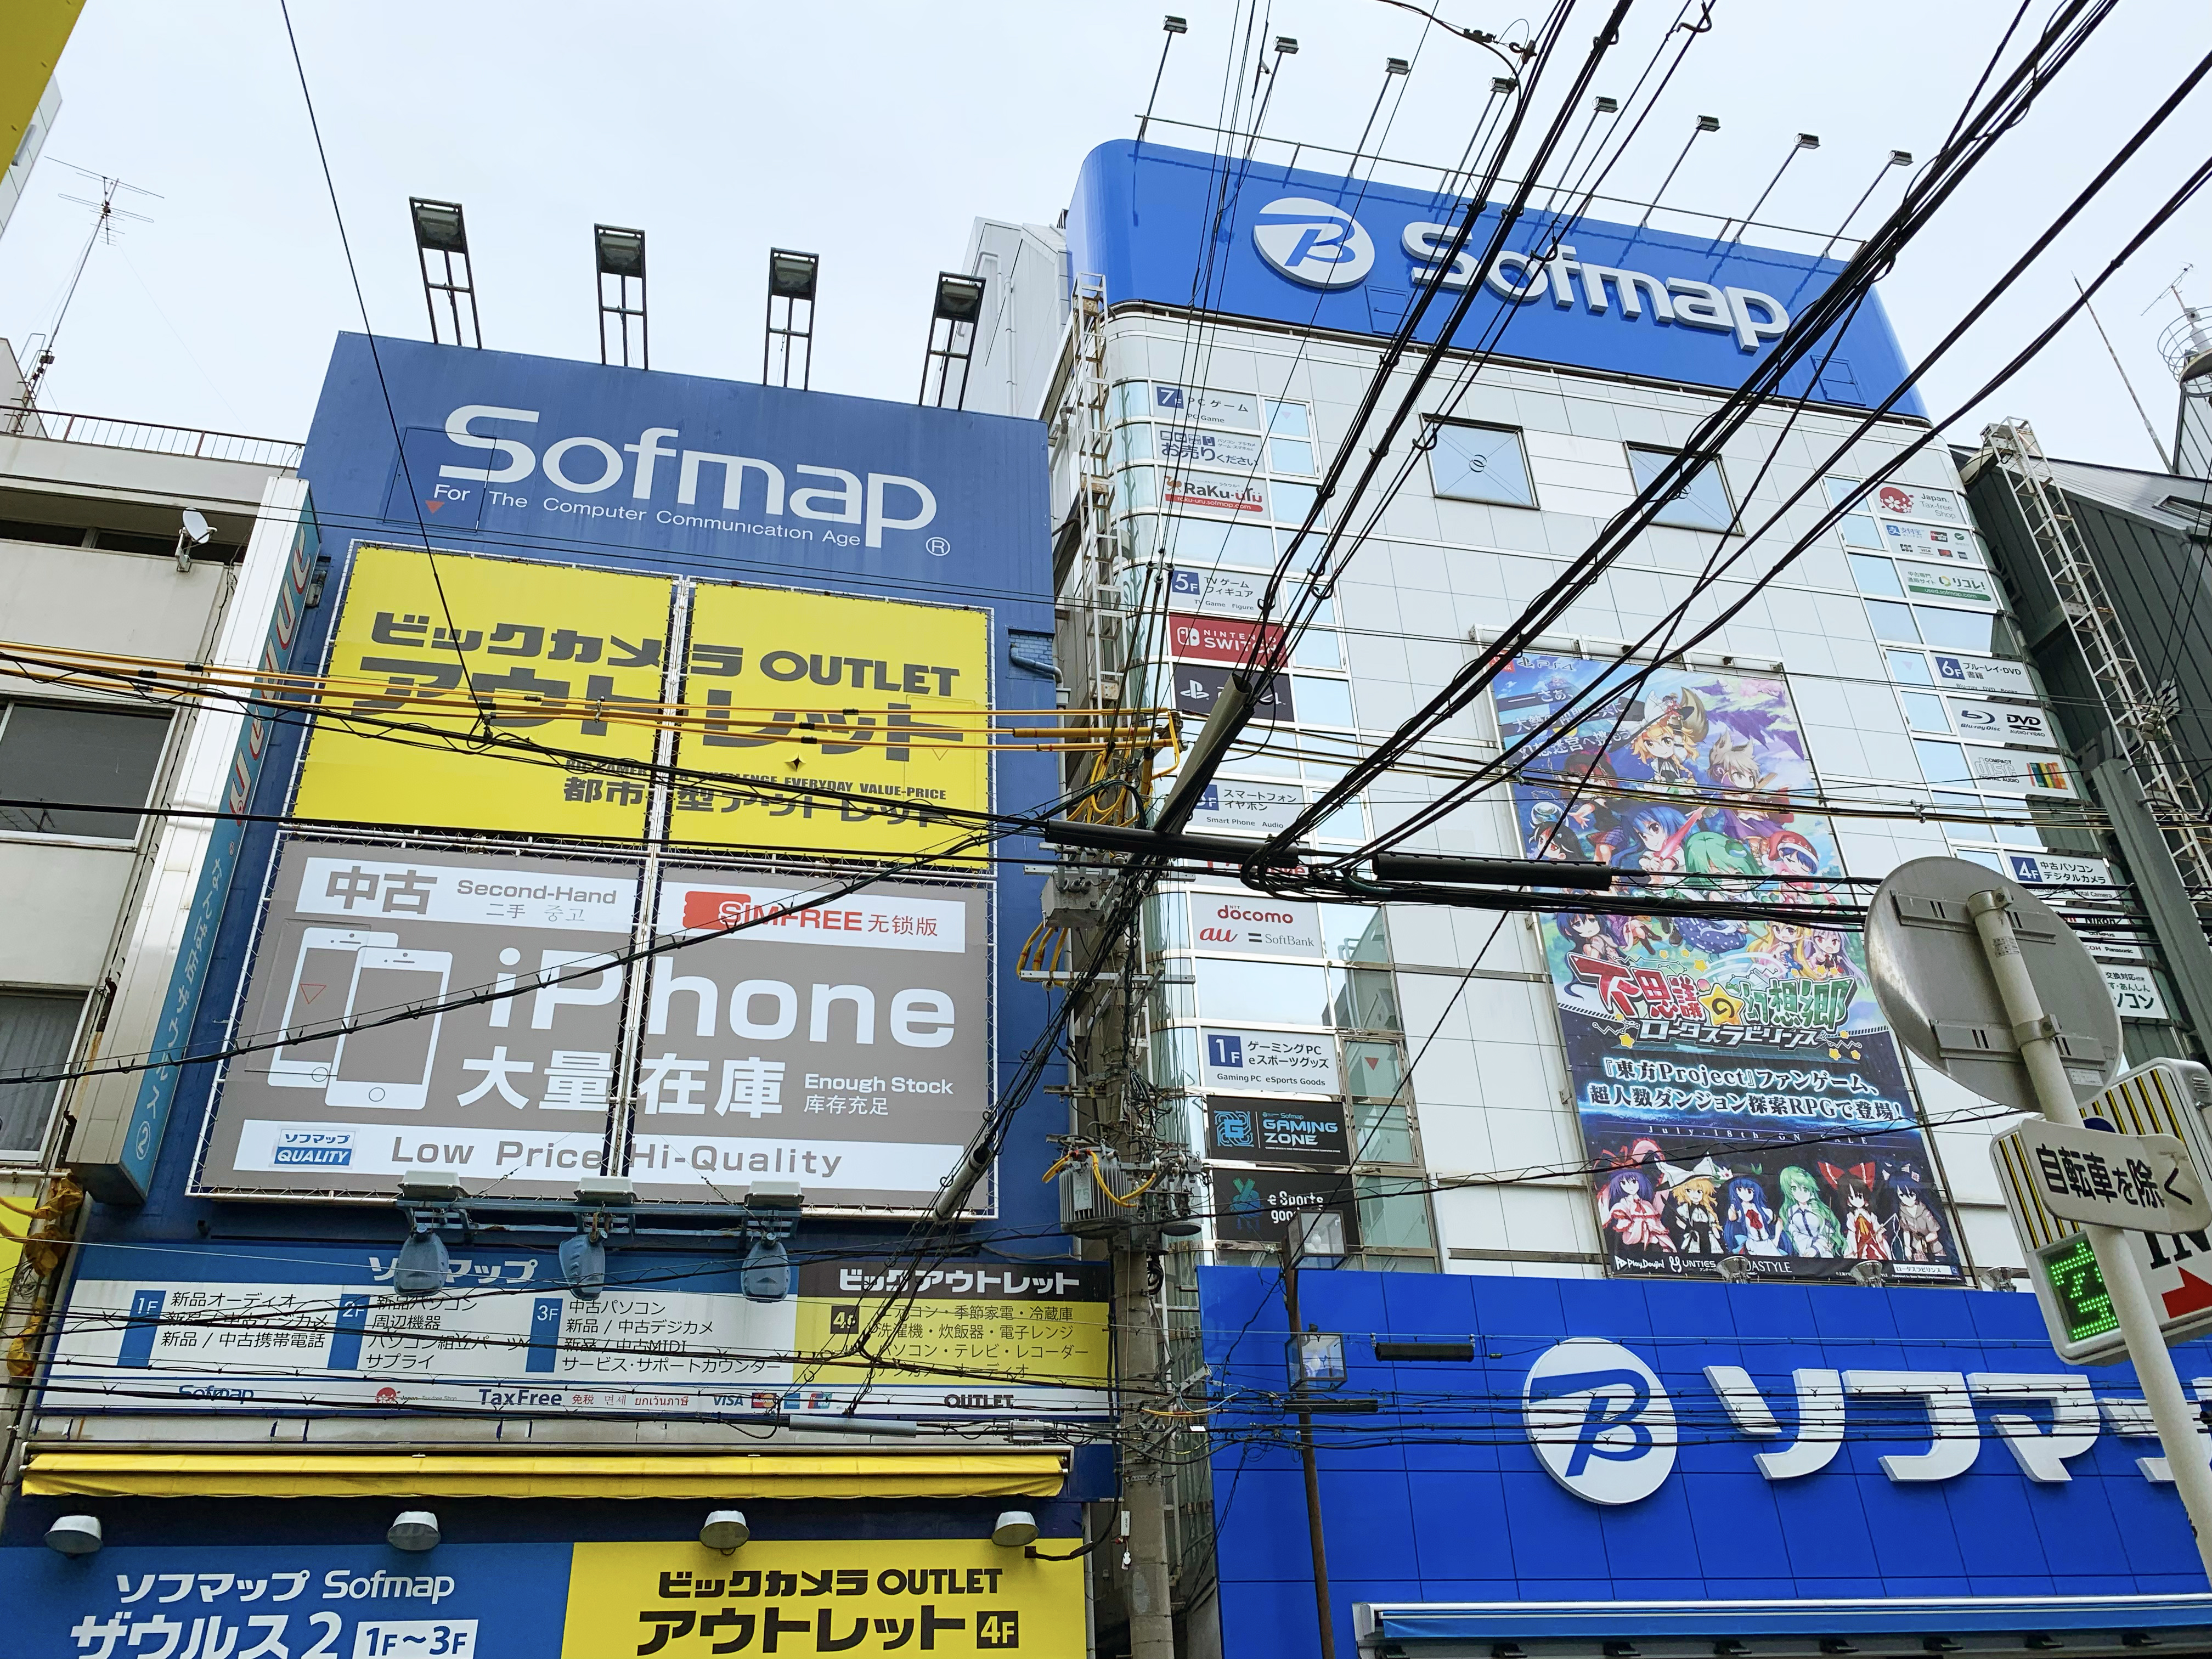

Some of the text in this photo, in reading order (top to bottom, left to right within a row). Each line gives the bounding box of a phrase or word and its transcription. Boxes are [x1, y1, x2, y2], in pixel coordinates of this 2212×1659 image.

[1402, 221, 1790, 352] Sofmap
[1160, 390, 1182, 407] 7F
[1161, 442, 1259, 466] お売りください
[439, 404, 937, 548] Sofmap
[1177, 496, 1251, 510] raku-uru.sofmap.com
[1920, 501, 1953, 511] Tax-free
[1921, 493, 1950, 503] Japan.
[433, 483, 860, 546] For The Computer Communication Age
[1936, 510, 1956, 520] Shop
[1175, 574, 1198, 592] 5F
[1207, 586, 1253, 597] フィギュア
[1204, 629, 1277, 643] NINTENO
[371, 612, 961, 696] ビックカメラ OUTLET
[1942, 660, 1962, 677] 6F
[1963, 662, 2022, 675] ブルーレイ・DVD
[351, 656, 963, 762] アウトレット
[2007, 714, 2041, 725] DVD
[2010, 729, 2045, 737] AUDIO/VIDEO
[785, 777, 853, 792] EVERYDAY
[860, 783, 946, 800] VALUE-PRICE
[1224, 789, 1296, 803] スマートフォン
[1224, 801, 1267, 811] イヤホン
[2019, 861, 2039, 879] 4F
[2040, 861, 2094, 873] 中古パソコン
[2043, 872, 2106, 884] デジタルカメラ
[326, 866, 617, 915] 中古 Second-Hand
[486, 904, 585, 923] 二手 중고
[718, 901, 939, 938] SIMFREE 无锁版
[1217, 905, 1293, 924] docomo
[1200, 928, 1314, 947] au SoftBank
[489, 947, 956, 1048] iPhone
[1574, 956, 1855, 1031] 不思議の幻想郷
[1639, 1019, 1825, 1048] ロータスラビリンス
[1215, 1039, 1240, 1063] 1F
[1248, 1041, 1322, 1055] ゲーミングPC
[1249, 1056, 1329, 1069] eスポーツグッズ
[456, 1045, 786, 1119] 大量在庫
[805, 1074, 953, 1095] Enough Stock
[1217, 1074, 1249, 1082] Gaming
[1266, 1076, 1297, 1085] eSports
[804, 1095, 889, 1116] 库存充足
[1263, 1119, 1338, 1134] GAMING
[285, 1132, 351, 1144] ソフマップ
[1264, 1132, 1318, 1147] ZONE
[278, 1148, 350, 1165] QUALITY
[391, 1136, 842, 1178] Low Price Hi-Quality
[2036, 1144, 2192, 1209] 自転車を除く
[369, 1257, 538, 1284] ソマップ
[839, 1268, 1079, 1295] ビックアウトレット
[138, 1297, 159, 1314] 1F
[171, 1291, 297, 1308] 新品オーディオ
[569, 1300, 665, 1315] 中古パソコン
[342, 1301, 364, 1318] 2F
[537, 1305, 559, 1321] 3F
[372, 1314, 441, 1330] 周辺機器
[566, 1318, 713, 1335] 新品 中古デジカメ
[161, 1330, 326, 1348] 新品 中古携帯電話
[877, 1323, 1074, 1340] 洗濯機・炊飯器・電子レンジ
[366, 1353, 435, 1369] サプライ
[562, 1357, 781, 1374] サービス・サポートカウンター
[179, 1385, 254, 1405] Sofmap
[479, 1389, 563, 1407] TaxFree
[572, 1394, 594, 1405] 免税
[605, 1394, 627, 1406] 면세
[713, 1396, 744, 1406] VISA
[944, 1394, 1014, 1408] OUTLET
[1703, 1365, 2212, 1483] ソフマッ
[116, 1570, 455, 1605] ソフマップ Sofmap
[658, 1568, 1003, 1599] ビックカメラ OUTLET
[70, 1611, 289, 1659] ザウルス
[307, 1611, 342, 1659] 2
[636, 1605, 1016, 1656] アウトレット 4F
